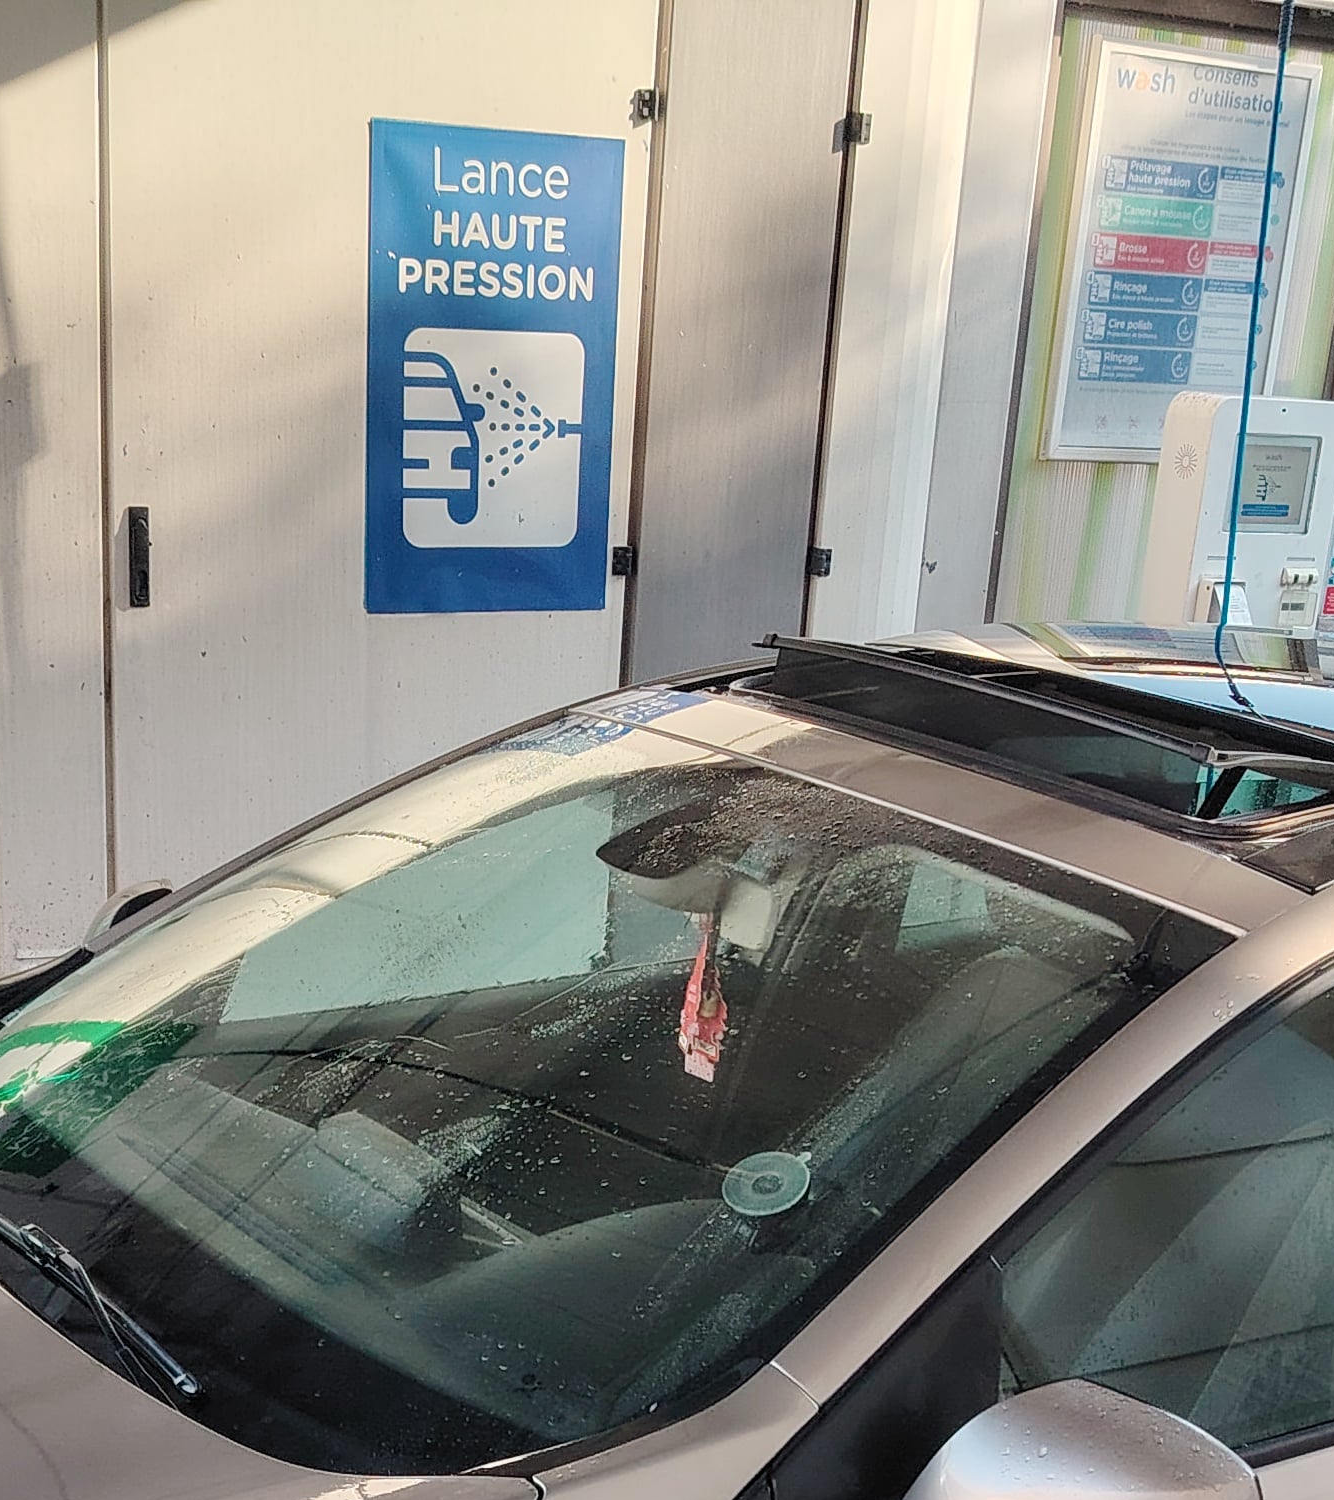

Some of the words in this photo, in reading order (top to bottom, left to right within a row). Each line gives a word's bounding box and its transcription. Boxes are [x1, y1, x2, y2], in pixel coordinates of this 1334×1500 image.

[1117, 65, 1175, 94] wash
[1193, 65, 1259, 88] Conseils
[433, 145, 569, 200] Lance
[1130, 158, 1172, 176] Prélavage
[1128, 173, 1153, 185] haute
[1154, 175, 1191, 189] pression
[432, 210, 567, 253] HAUTE
[397, 257, 595, 302] PRESSION
[1113, 281, 1148, 294] Rinçage
[1108, 318, 1126, 330] Cire
[1127, 319, 1153, 332] polish
[1103, 351, 1139, 365] Rinçage
